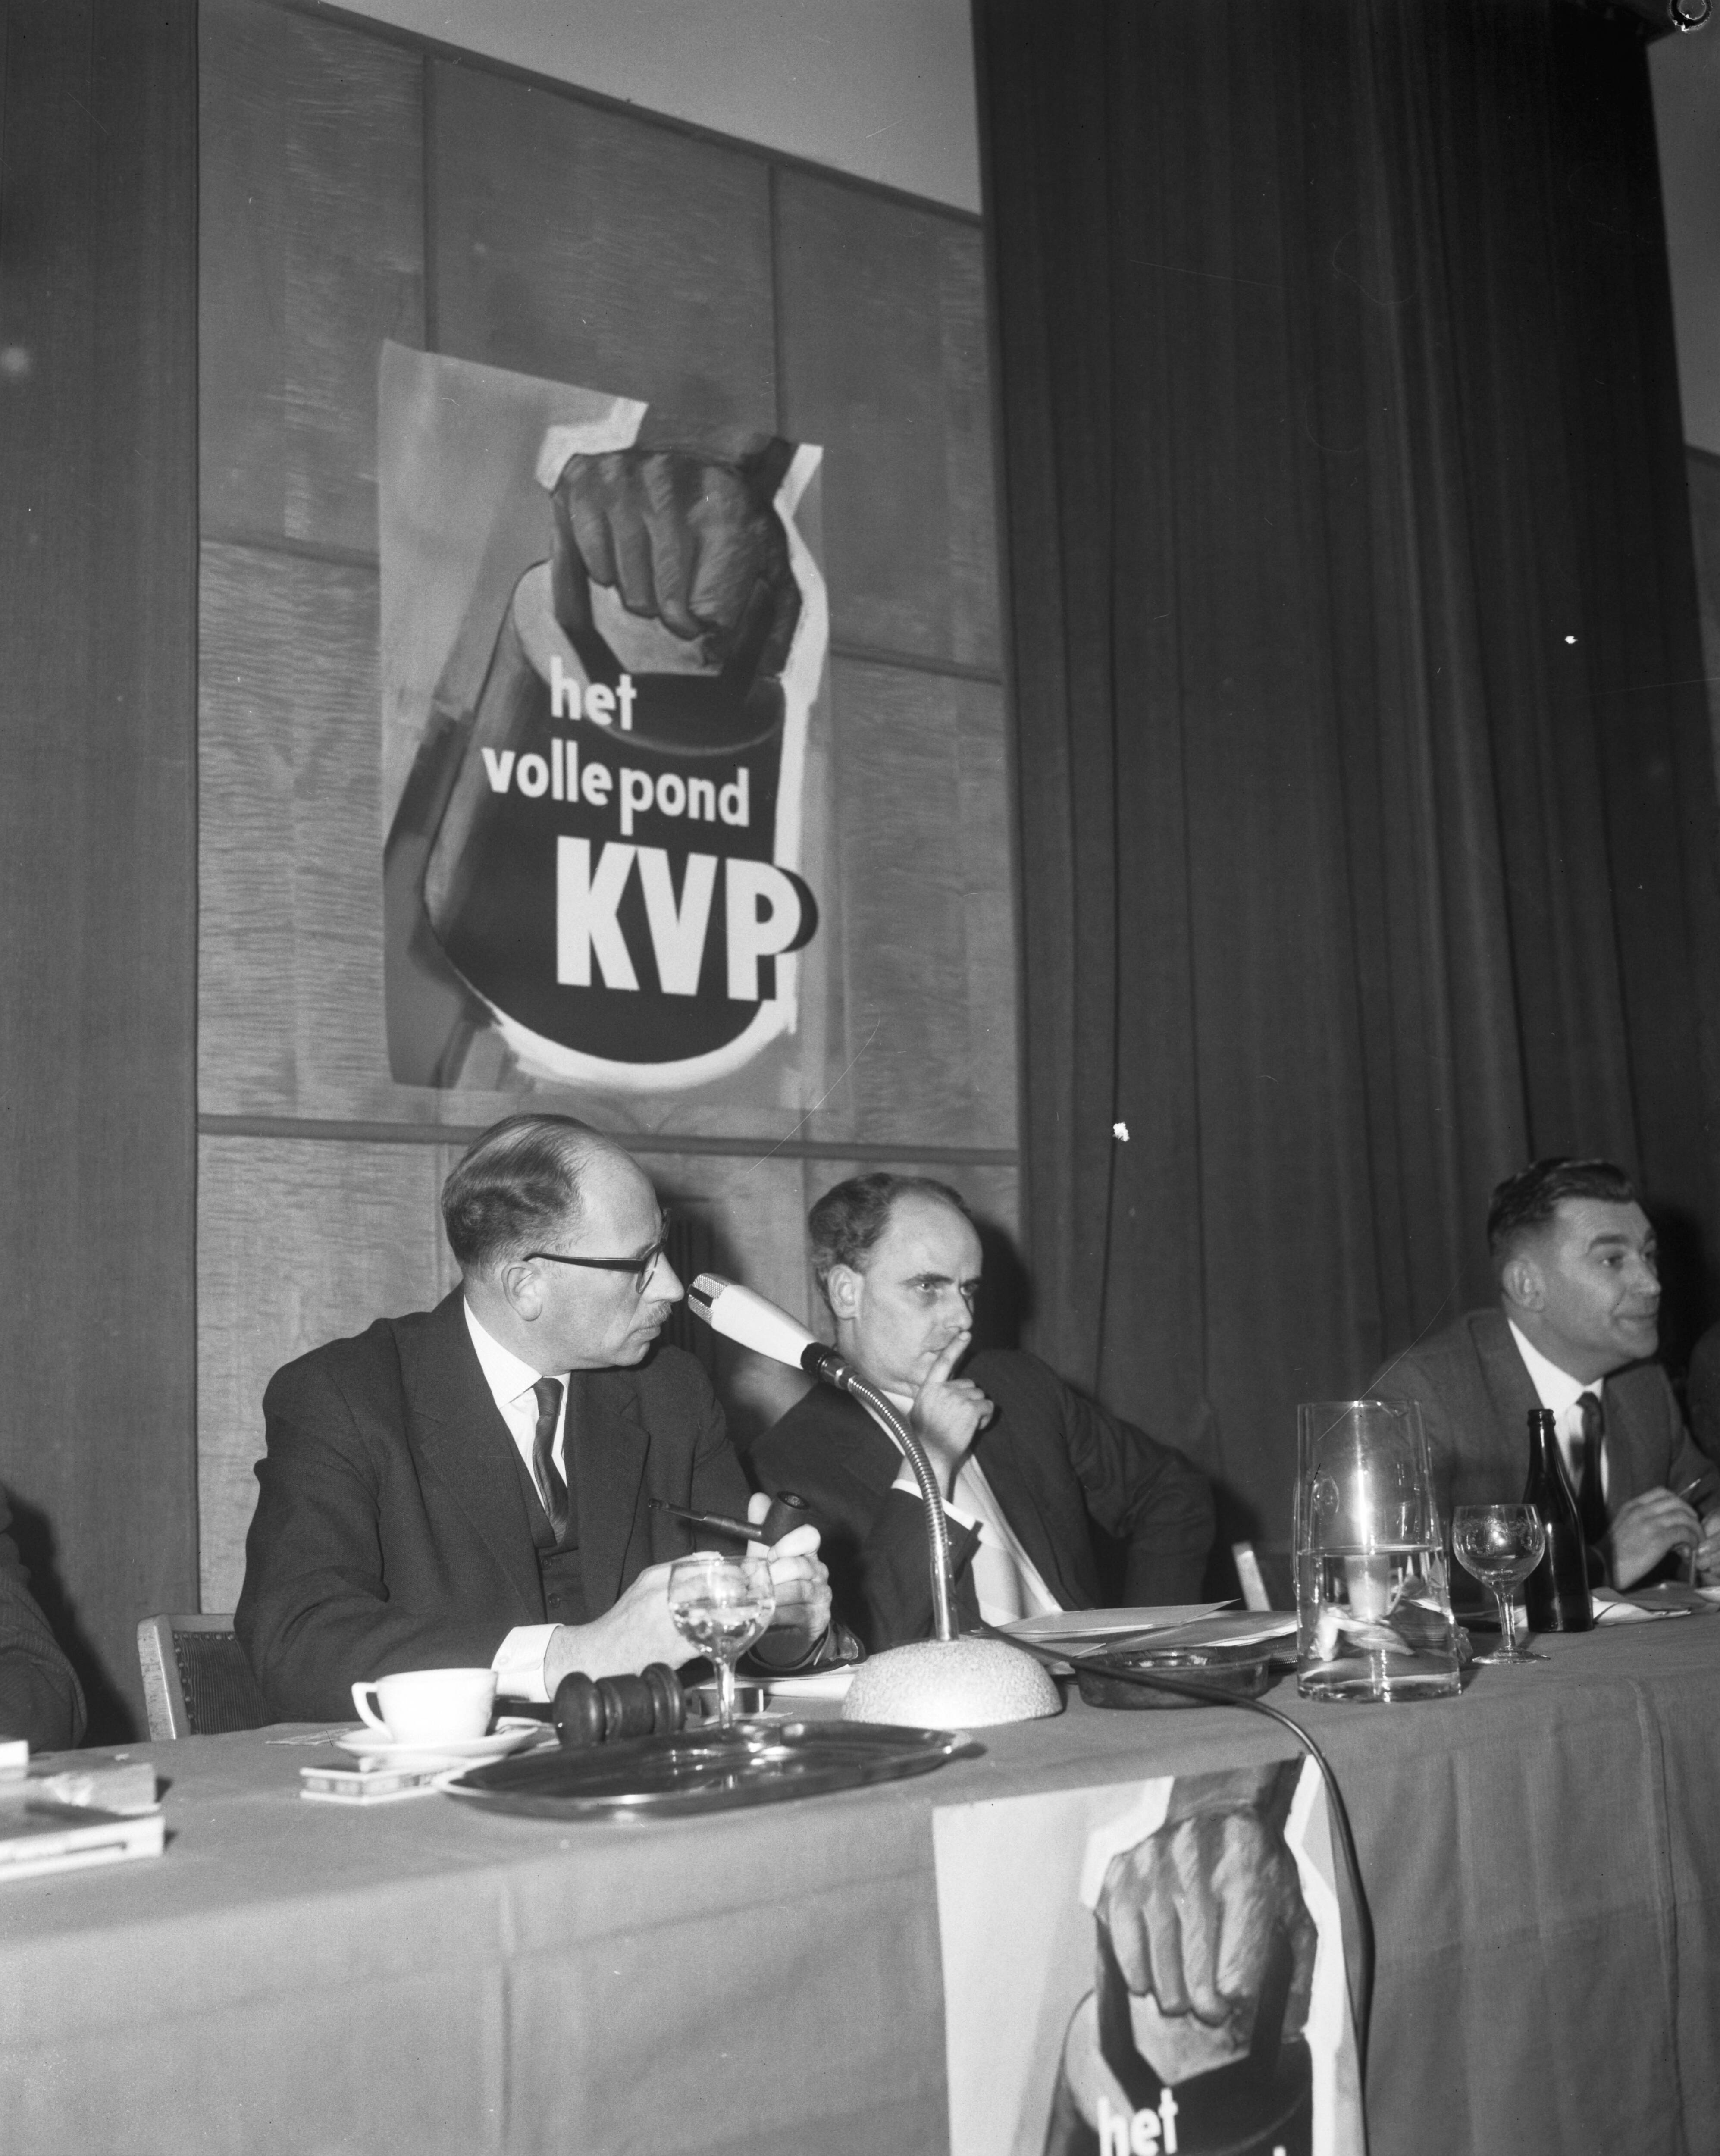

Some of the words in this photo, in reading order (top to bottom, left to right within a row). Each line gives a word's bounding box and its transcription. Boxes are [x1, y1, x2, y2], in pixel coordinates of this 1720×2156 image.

[551, 656, 636, 730] het
[482, 738, 612, 805] volle
[620, 767, 749, 836] pond
[557, 835, 801, 1001] KVP
[1097, 2087, 1178, 2156] het
